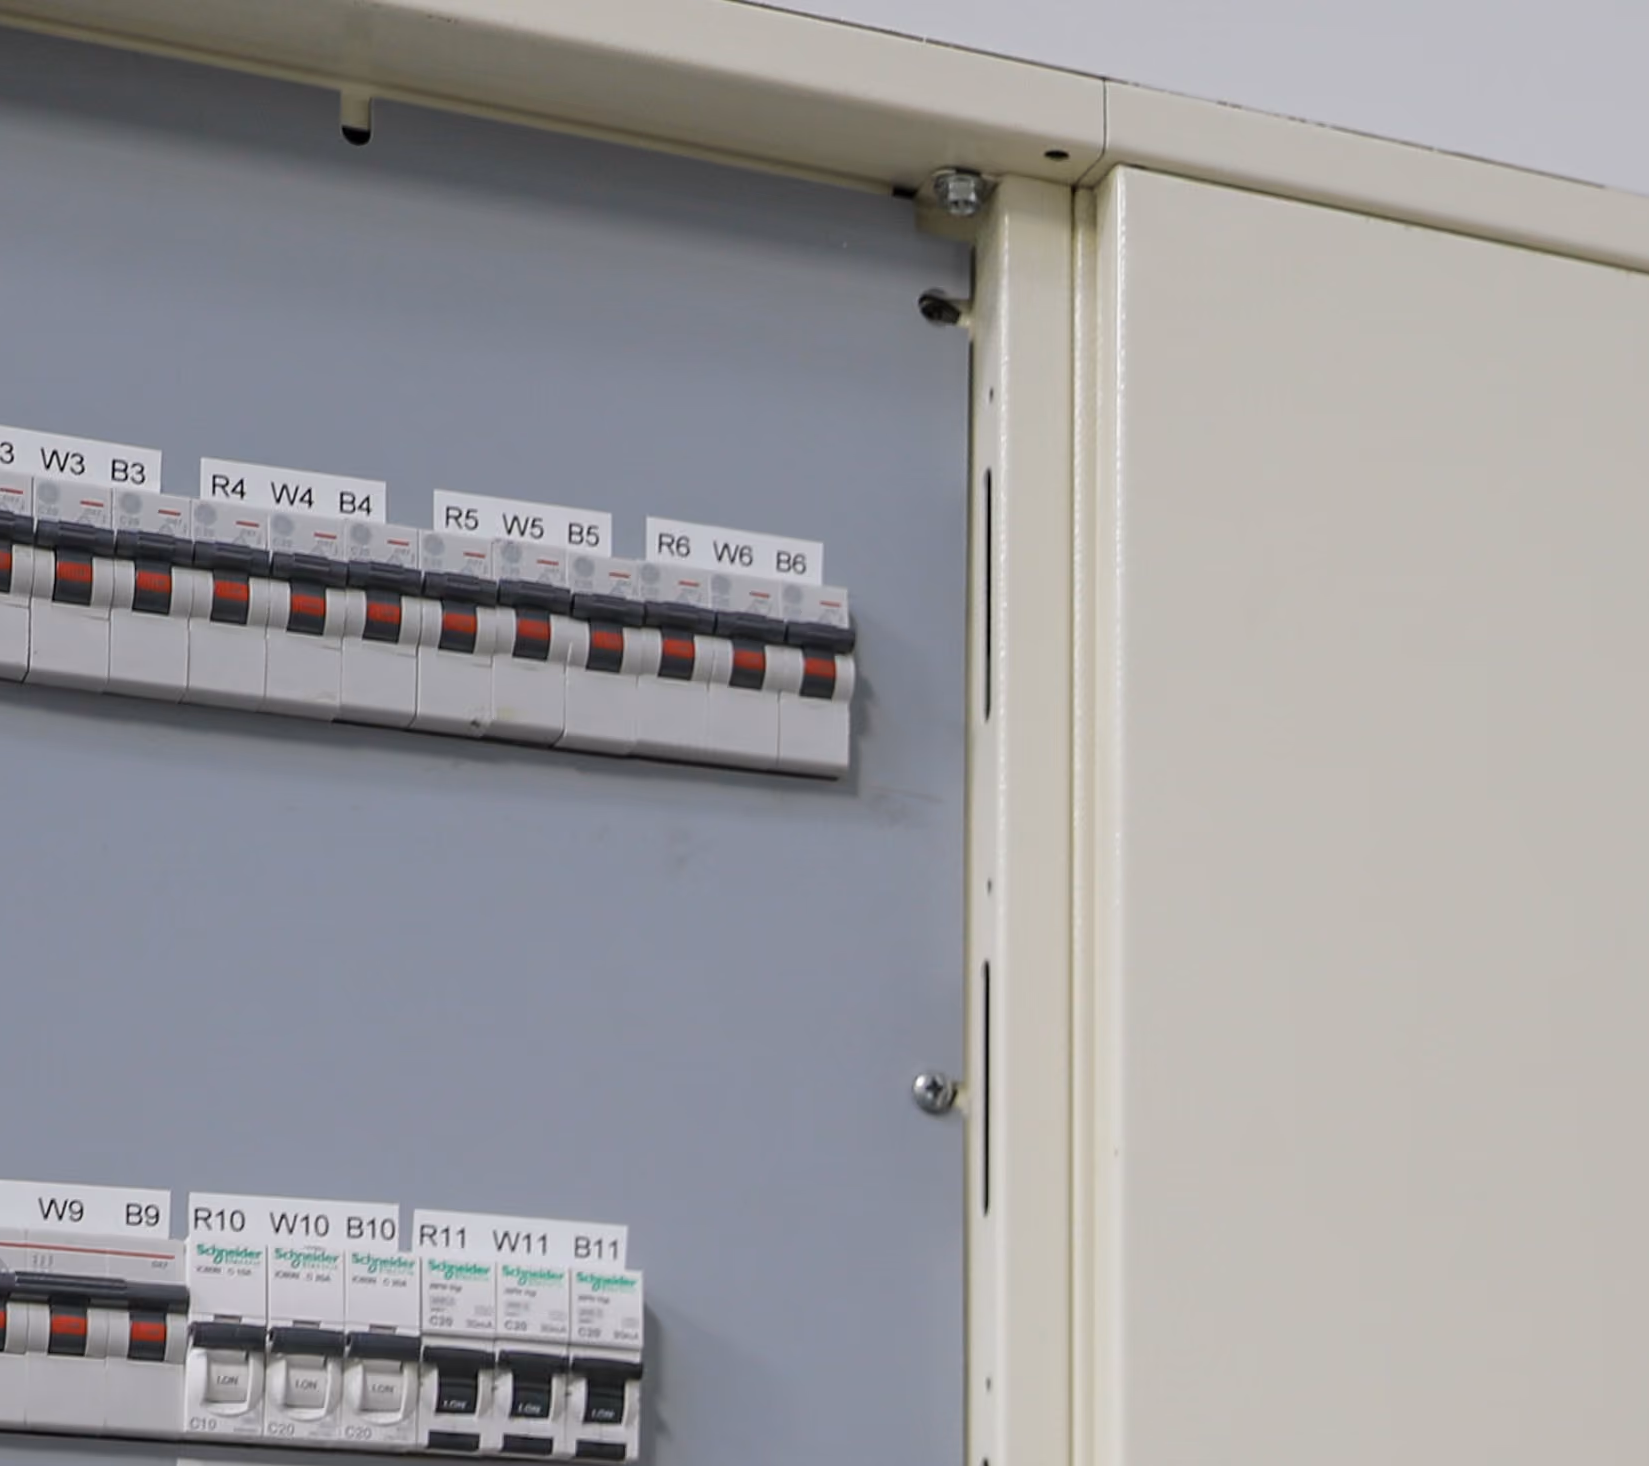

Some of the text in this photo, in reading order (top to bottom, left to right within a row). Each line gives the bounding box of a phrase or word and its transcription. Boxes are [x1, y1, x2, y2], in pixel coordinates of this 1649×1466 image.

[40, 447, 86, 476] W3
[111, 458, 146, 485] B3
[211, 474, 372, 516] R4 W4 B4
[445, 505, 600, 547] R5 W5 B5
[657, 532, 807, 575] R6 W6 B6
[38, 1197, 84, 1223] W9
[125, 1203, 160, 1227] B9
[193, 1207, 396, 1241] R10 W10 B10
[419, 1224, 618, 1260] R11 W11 B11
[196, 1243, 263, 1264] Schneider
[274, 1247, 340, 1269] Schneider
[351, 1252, 416, 1274] Schneider
[428, 1258, 490, 1280] Schneider
[501, 1264, 565, 1285] Schneider
[575, 1271, 638, 1293] Schneider
[428, 1315, 454, 1329] C20
[503, 1318, 529, 1333] C20
[577, 1325, 602, 1339] C20
[189, 1416, 218, 1431] C10
[267, 1421, 296, 1436] C20
[344, 1425, 372, 1440] C20
